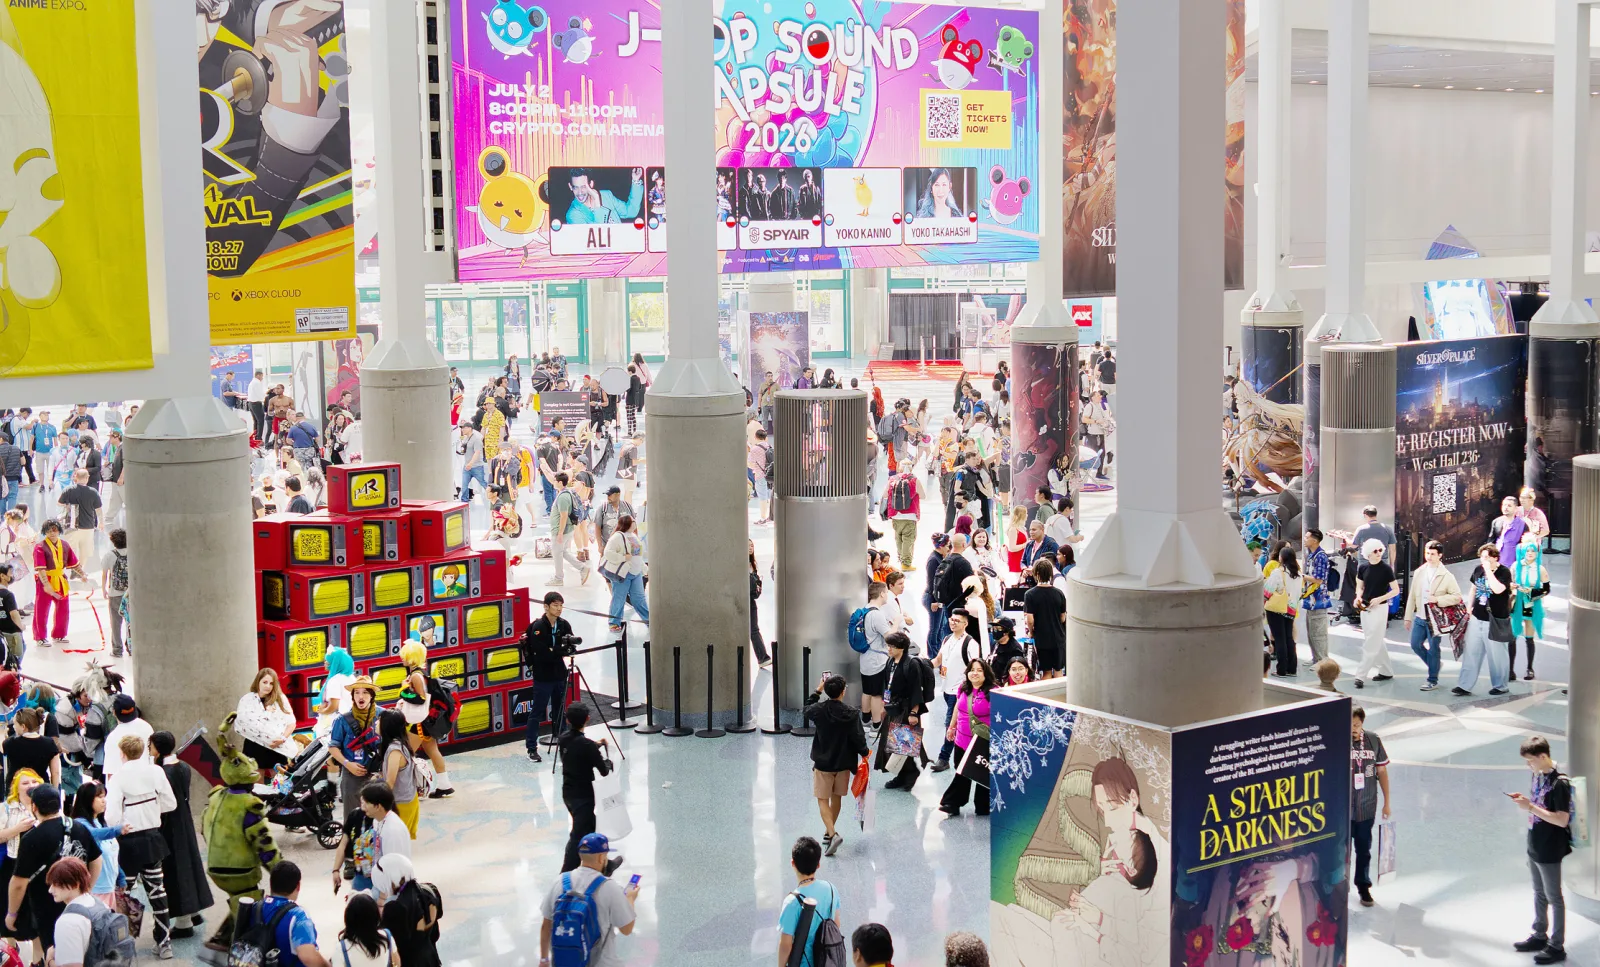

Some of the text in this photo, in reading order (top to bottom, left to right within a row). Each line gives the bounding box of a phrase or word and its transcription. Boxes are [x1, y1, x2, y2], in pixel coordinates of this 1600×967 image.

[775, 20, 920, 71] SOUND
[488, 84, 550, 98] JULY 2
[488, 102, 558, 117] 8:00PM
[569, 104, 638, 118] 11:00PM
[966, 104, 984, 112] GET
[966, 114, 1008, 123] TICKETS
[489, 121, 665, 137] CRYPTO.COM ARENA
[966, 126, 989, 134] NOW!
[744, 122, 811, 153] 2026
[586, 227, 612, 248] ALI
[762, 228, 810, 242] SPYAIR
[836, 228, 892, 240] YOKO KANNO
[911, 226, 972, 239] YOKO TAKAHASHI
[208, 288, 302, 300] PC XBOX CLOUD
[298, 316, 309, 328] RP
[1416, 349, 1476, 365] SILVER PALACE
[1478, 422, 1508, 442] NOW
[1412, 450, 1478, 472] West Hall 236
[513, 700, 534, 714] ATL
[1218, 741, 1244, 751] struggling
[1274, 729, 1292, 739] himself
[1209, 754, 1232, 763] darkness
[1232, 751, 1239, 759] by
[1269, 740, 1289, 750] talented
[1289, 738, 1306, 746] author
[1212, 775, 1231, 783] creator
[1231, 771, 1238, 779] of
[1255, 764, 1271, 774] smash
[1297, 755, 1314, 765] Magic!
[1234, 755, 1267, 769] psychological
[1268, 753, 1285, 761] drama
[1202, 769, 1324, 826] A STARLIT
[1200, 802, 1326, 860] DARKNESS
